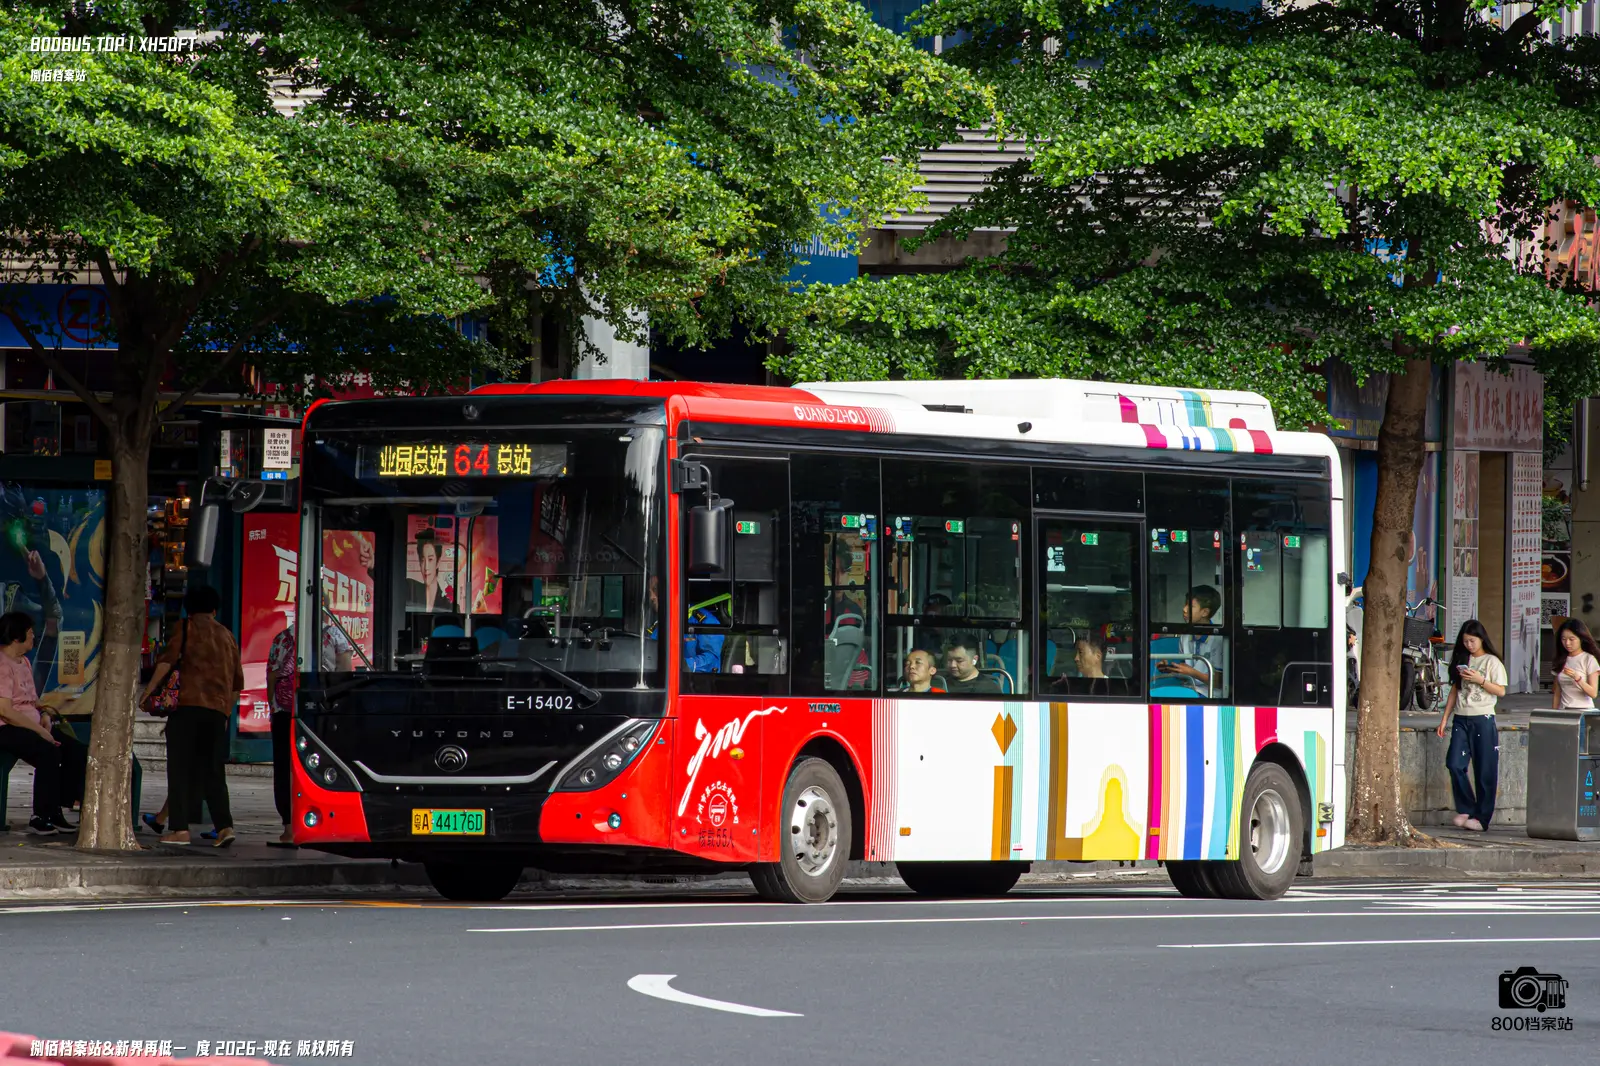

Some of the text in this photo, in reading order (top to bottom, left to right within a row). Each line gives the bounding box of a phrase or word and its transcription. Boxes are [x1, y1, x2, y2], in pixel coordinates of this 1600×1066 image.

[793, 405, 866, 424] GUANGZHOU
[379, 444, 531, 476] 业园总站 64 总站
[507, 695, 573, 710] E-15402
[391, 730, 514, 738] YUTONG
